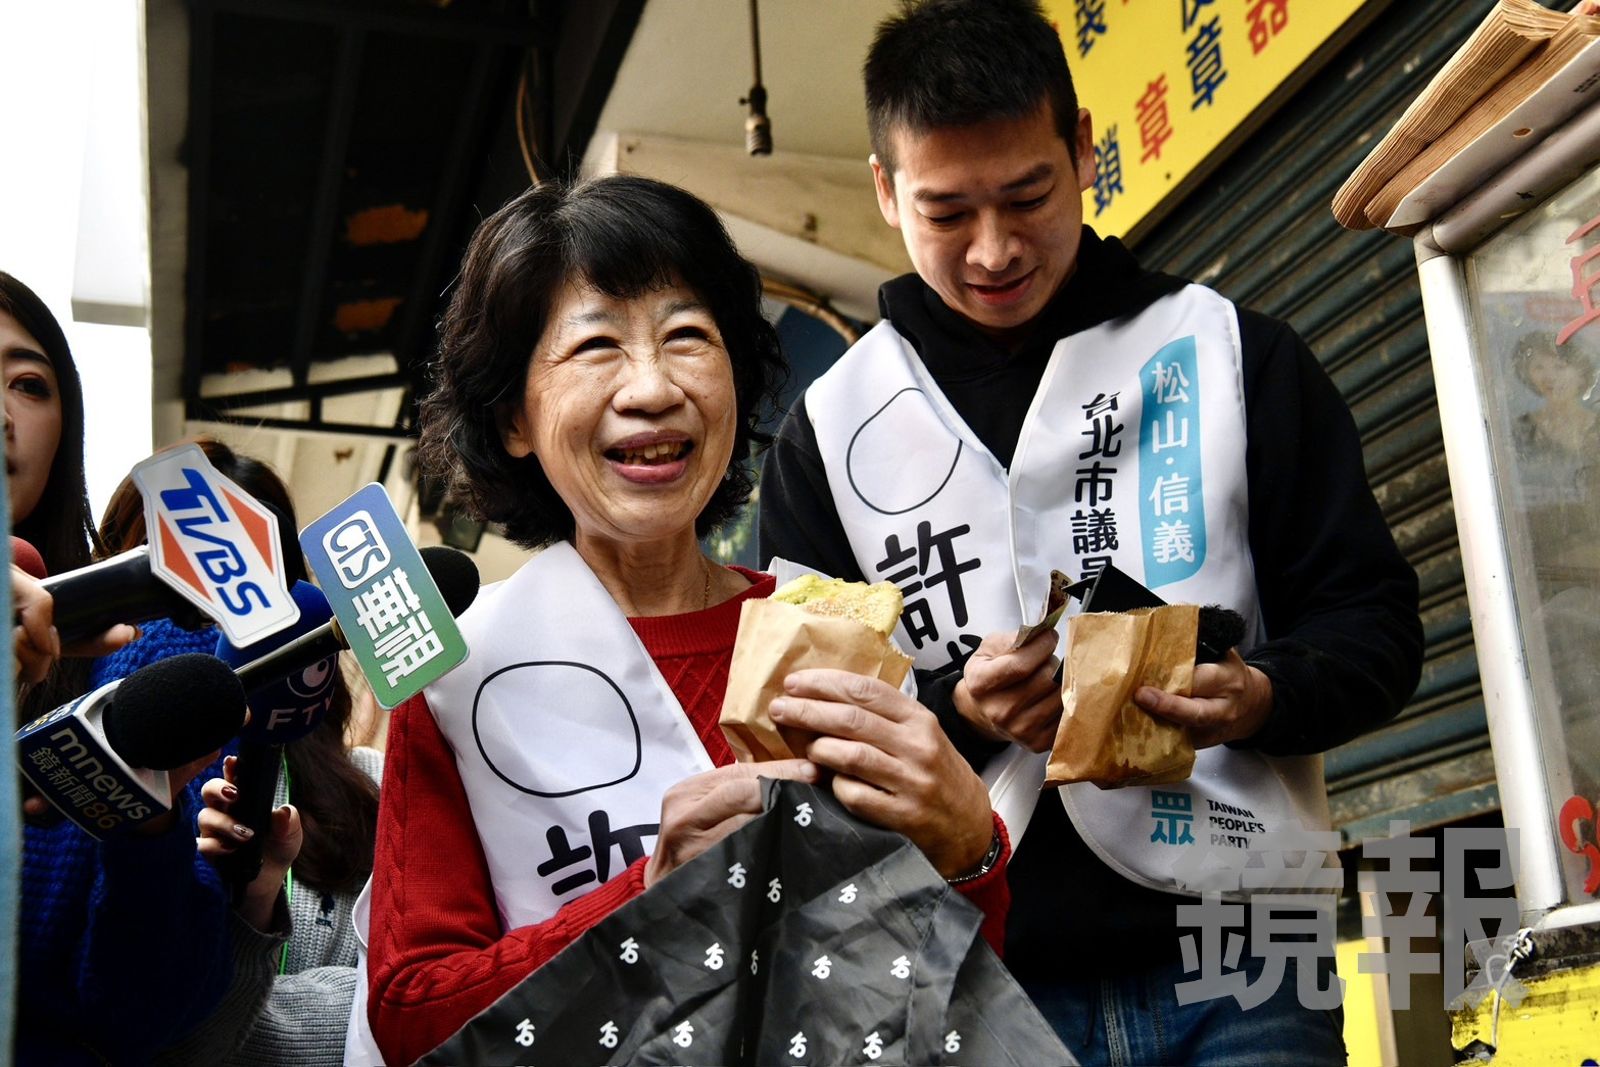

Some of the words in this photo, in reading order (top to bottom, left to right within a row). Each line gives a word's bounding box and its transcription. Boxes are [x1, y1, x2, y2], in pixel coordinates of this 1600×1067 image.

[1135, 73, 1173, 165] 章
[160, 467, 271, 616] TVBS
[329, 518, 386, 582] CTS
[351, 566, 445, 689] 華視
[876, 520, 983, 675] 許
[50, 727, 151, 820] mnews
[1206, 799, 1256, 819] TAIWAN
[1208, 816, 1266, 834] PEOPLE'S
[1209, 833, 1252, 850] PARTY
